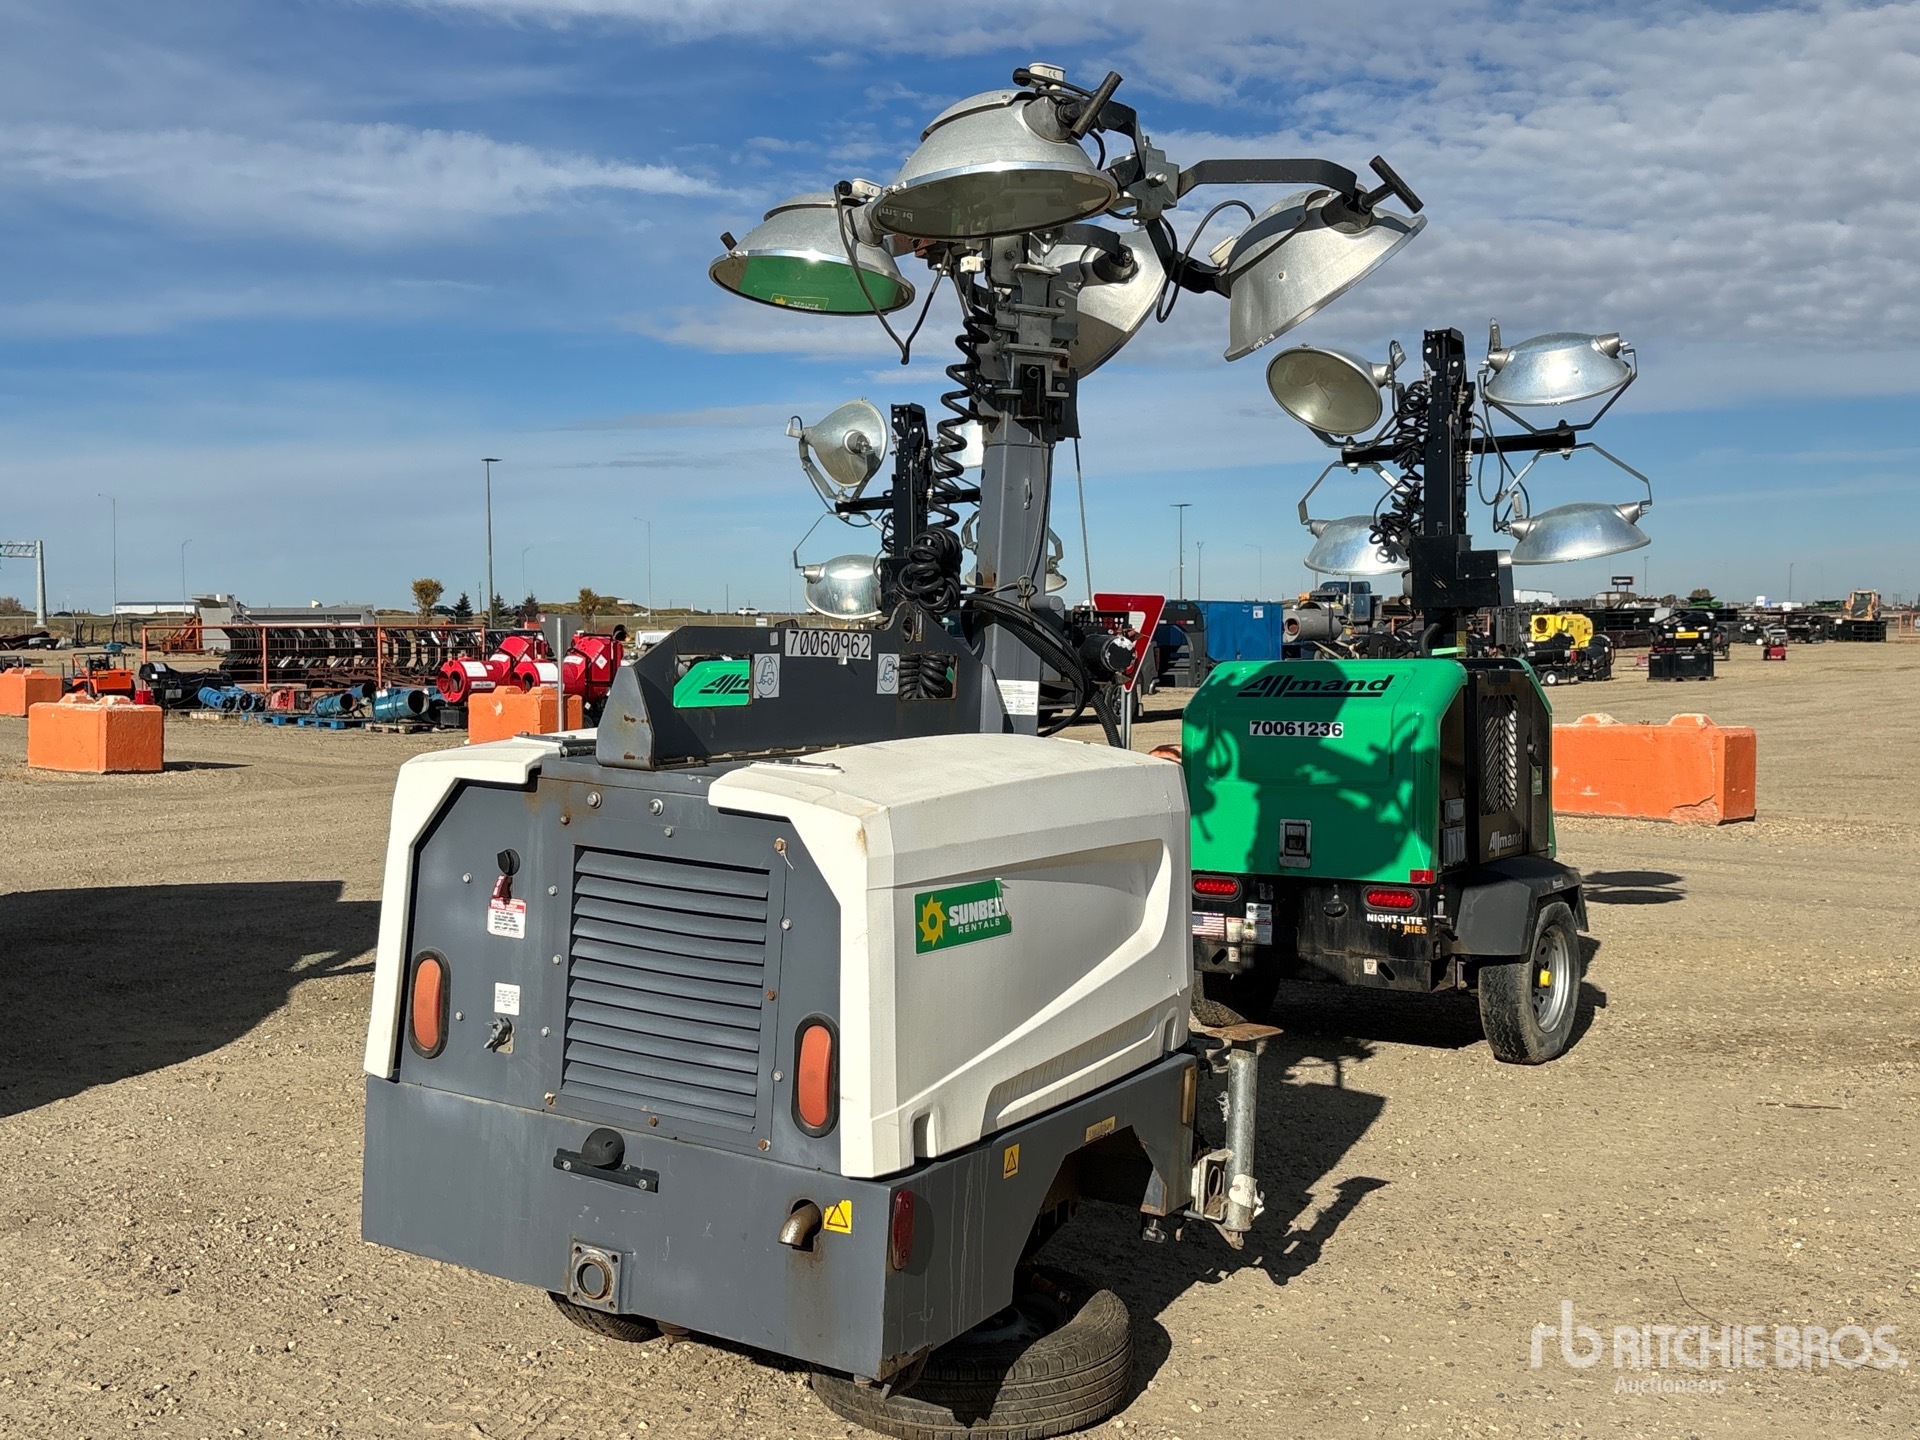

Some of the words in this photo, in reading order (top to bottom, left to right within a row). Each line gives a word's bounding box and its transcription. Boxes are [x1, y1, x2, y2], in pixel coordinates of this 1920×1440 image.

[790, 630, 870, 658] 70060962
[1236, 674, 1395, 697] Allmand
[1251, 721, 1343, 737] 70061236
[958, 918, 1001, 934] RENTALS
[1366, 913, 1424, 926] NIGHT-LITE
[1391, 923, 1427, 935] SRIES
